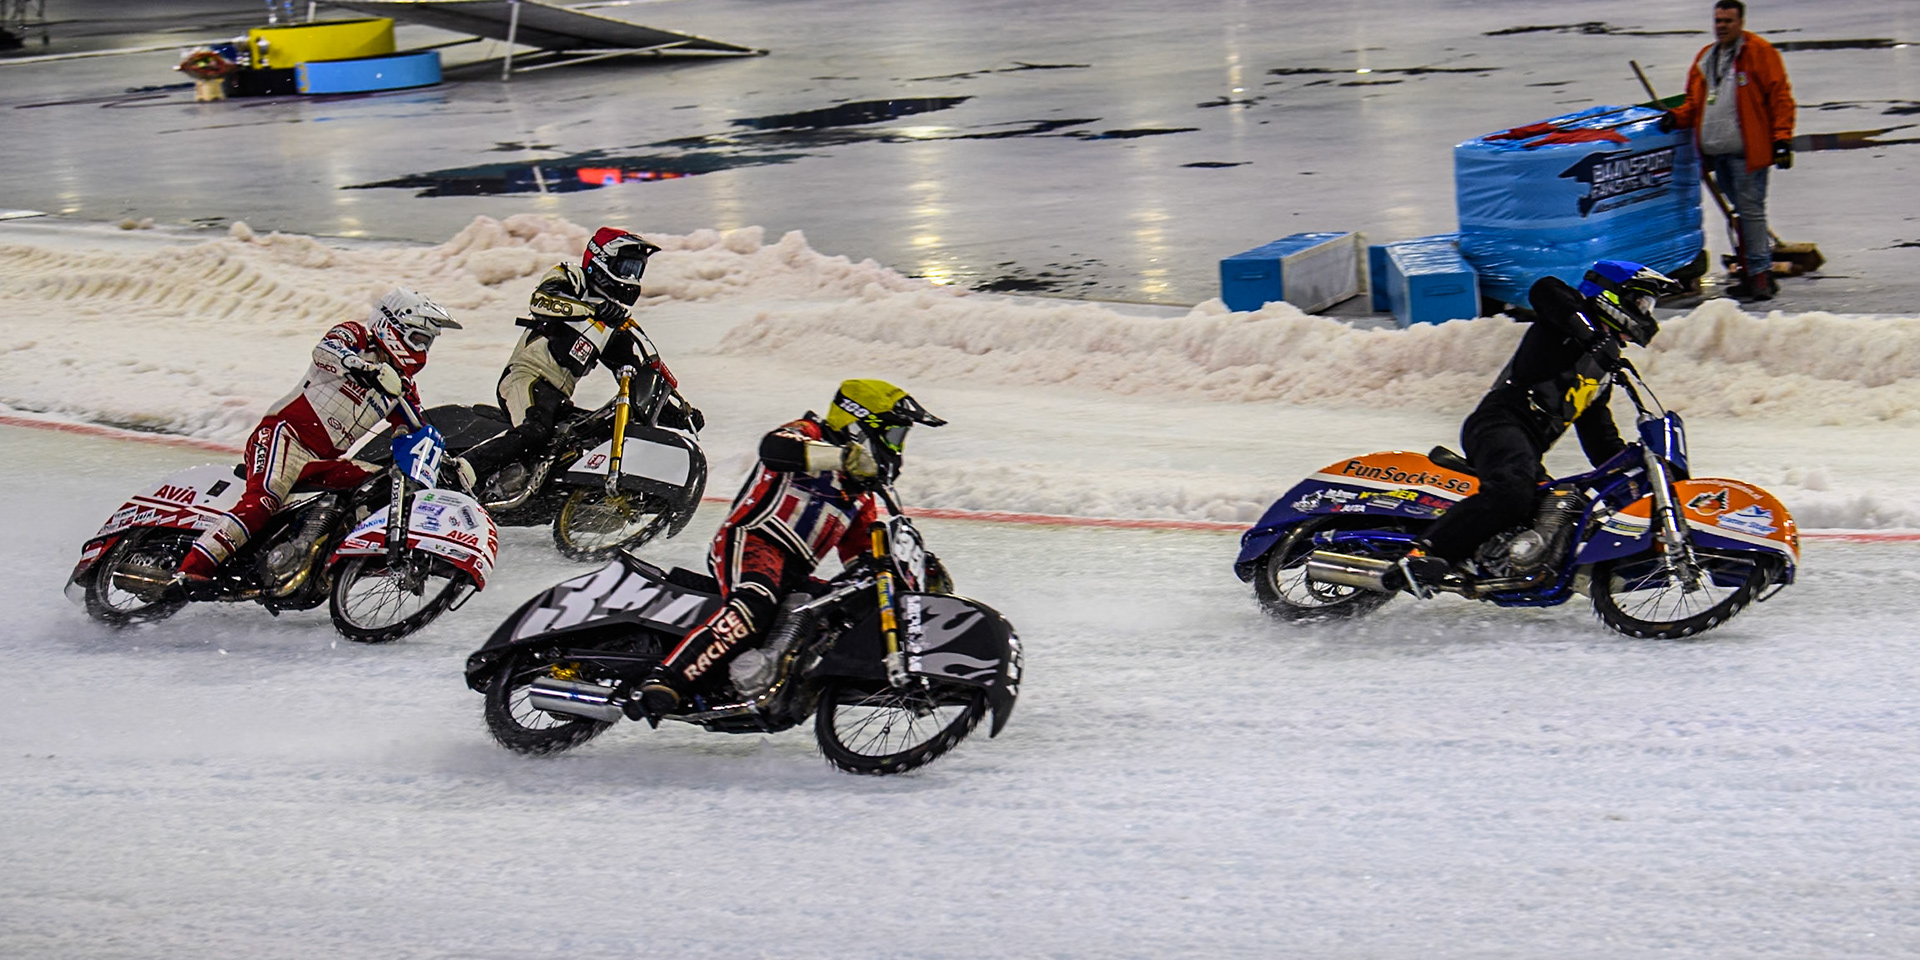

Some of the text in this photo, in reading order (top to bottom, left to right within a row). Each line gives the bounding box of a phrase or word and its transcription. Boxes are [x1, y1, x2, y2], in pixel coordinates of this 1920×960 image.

[380, 304, 410, 334] 100%
[839, 397, 883, 429] 100%
[1342, 460, 1471, 493] FunSocks.se
[683, 622, 749, 682] RACING
